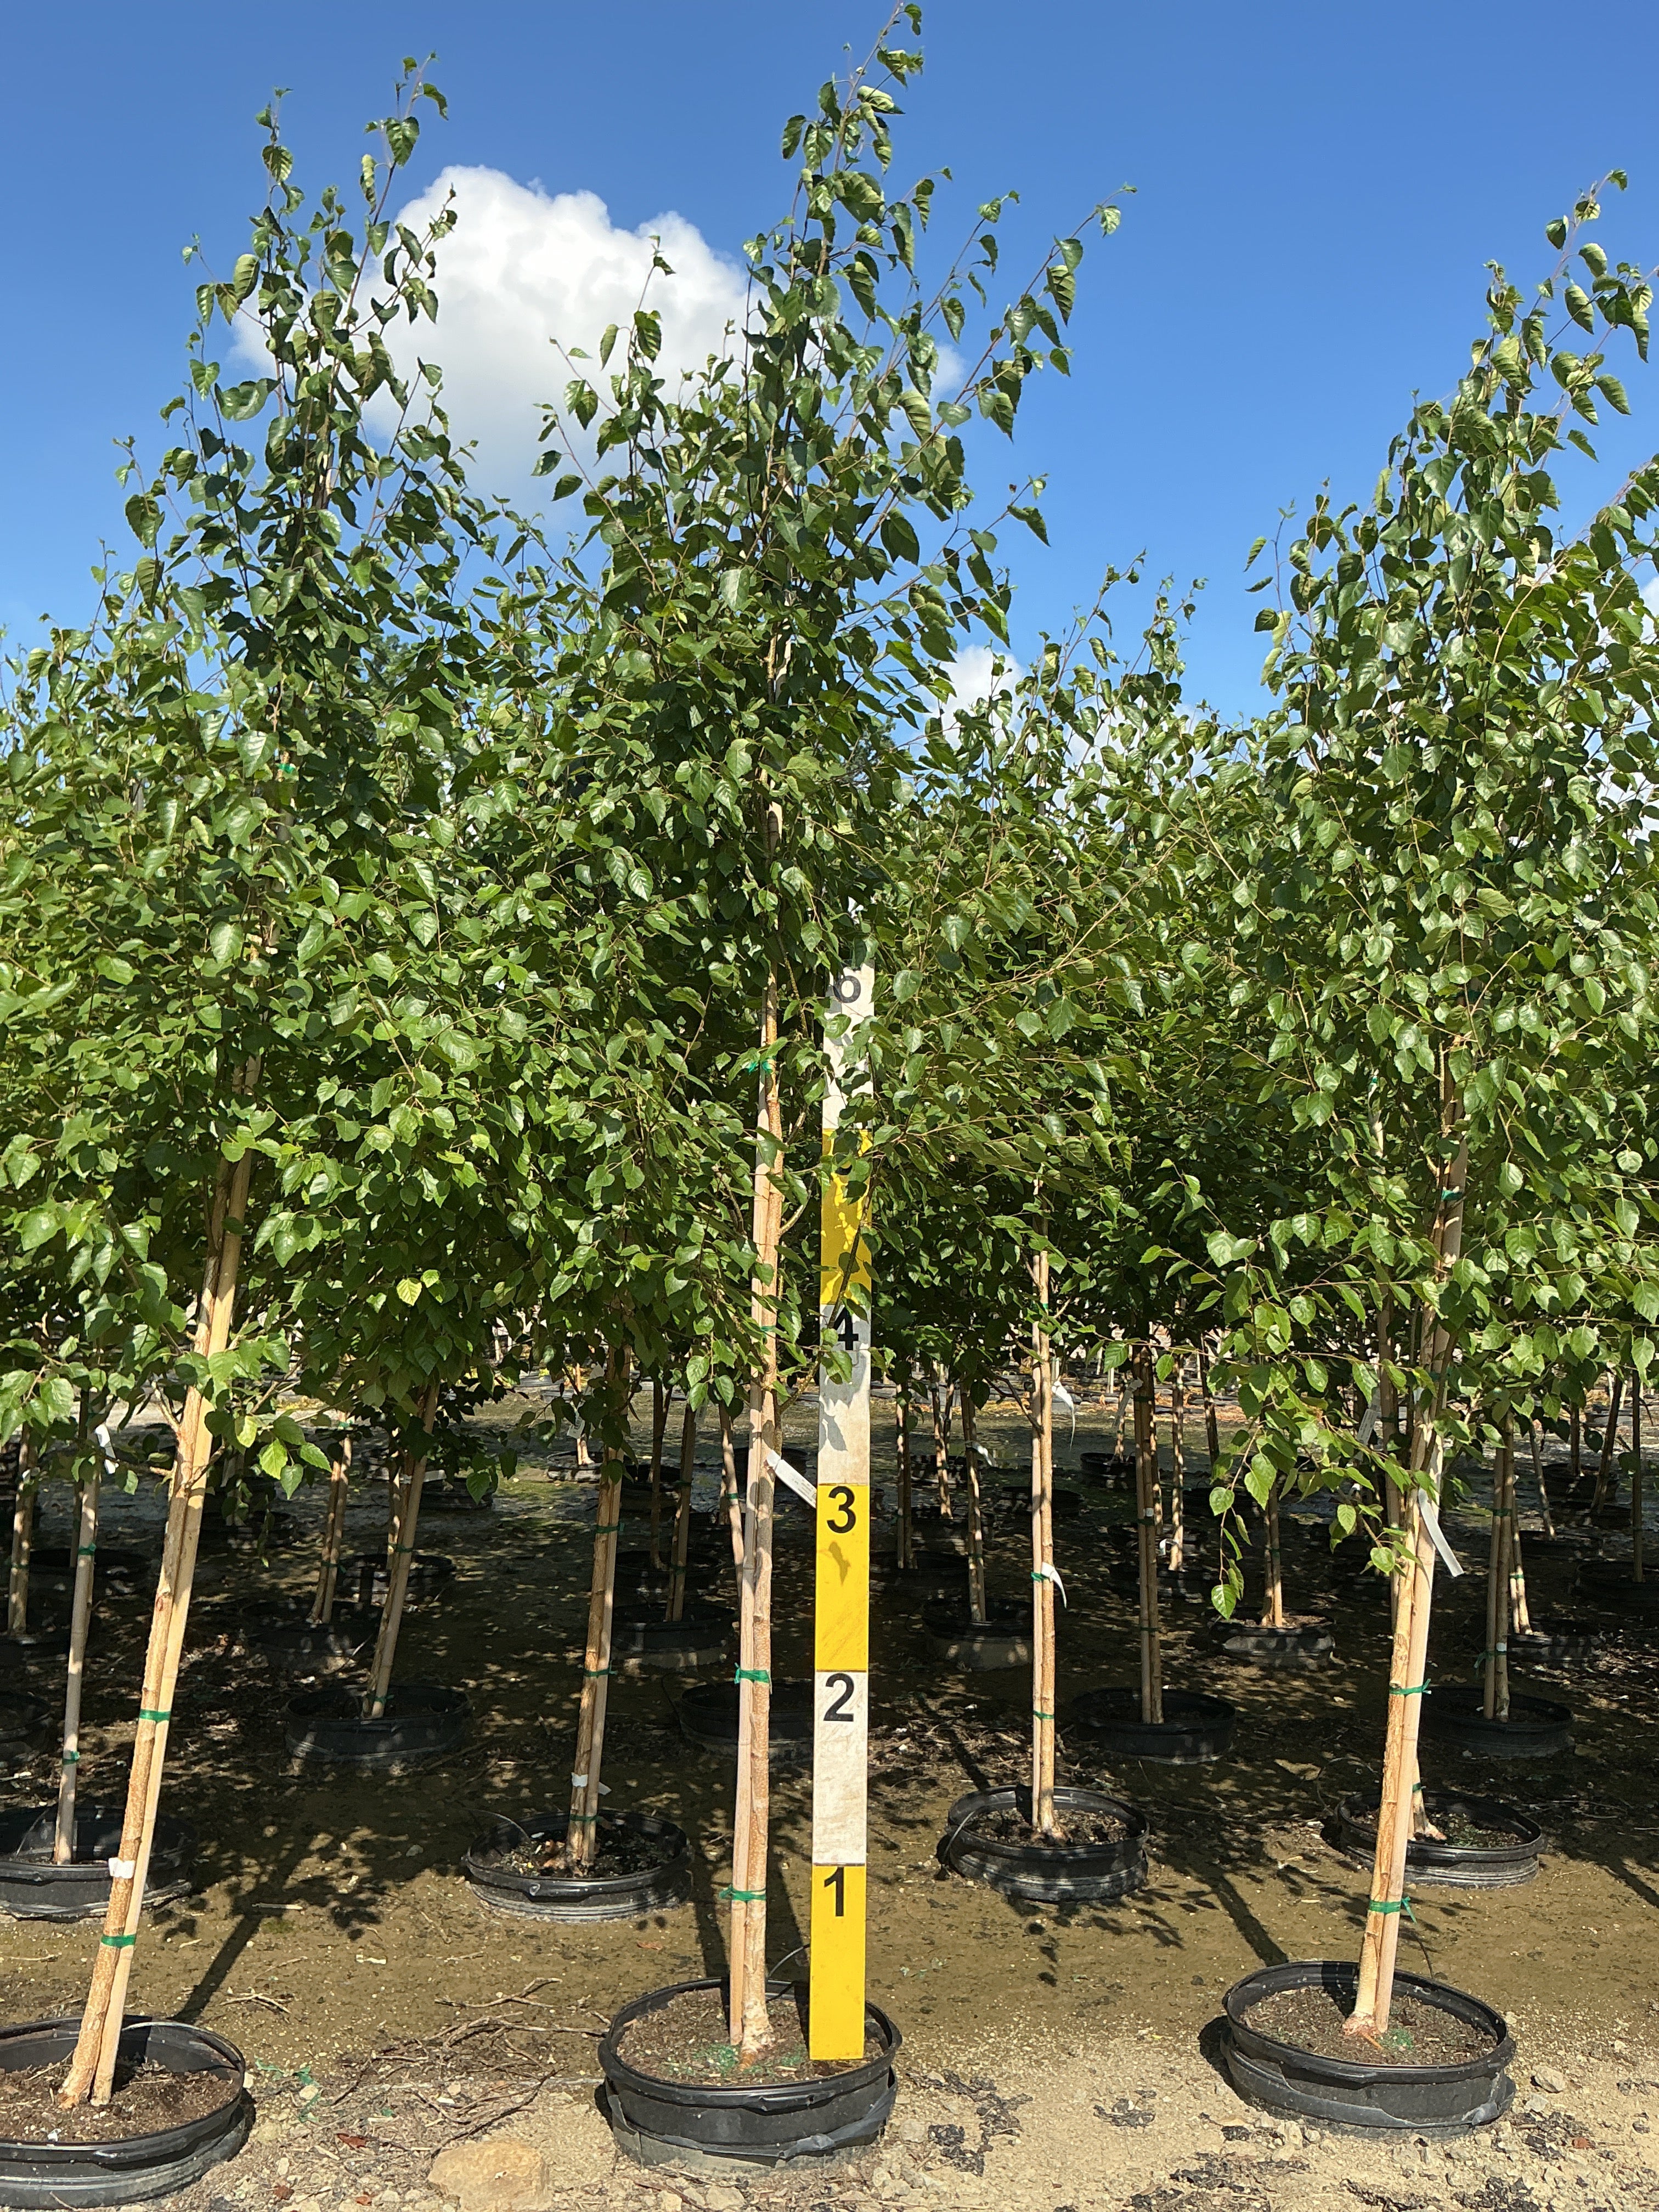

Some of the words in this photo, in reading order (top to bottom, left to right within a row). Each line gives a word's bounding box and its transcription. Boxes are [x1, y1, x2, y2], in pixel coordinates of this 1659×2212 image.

[828, 1305, 859, 1351] 4
[827, 1486, 856, 1533] 3
[823, 1673, 855, 1722] 2
[823, 1866, 844, 1917] 1
